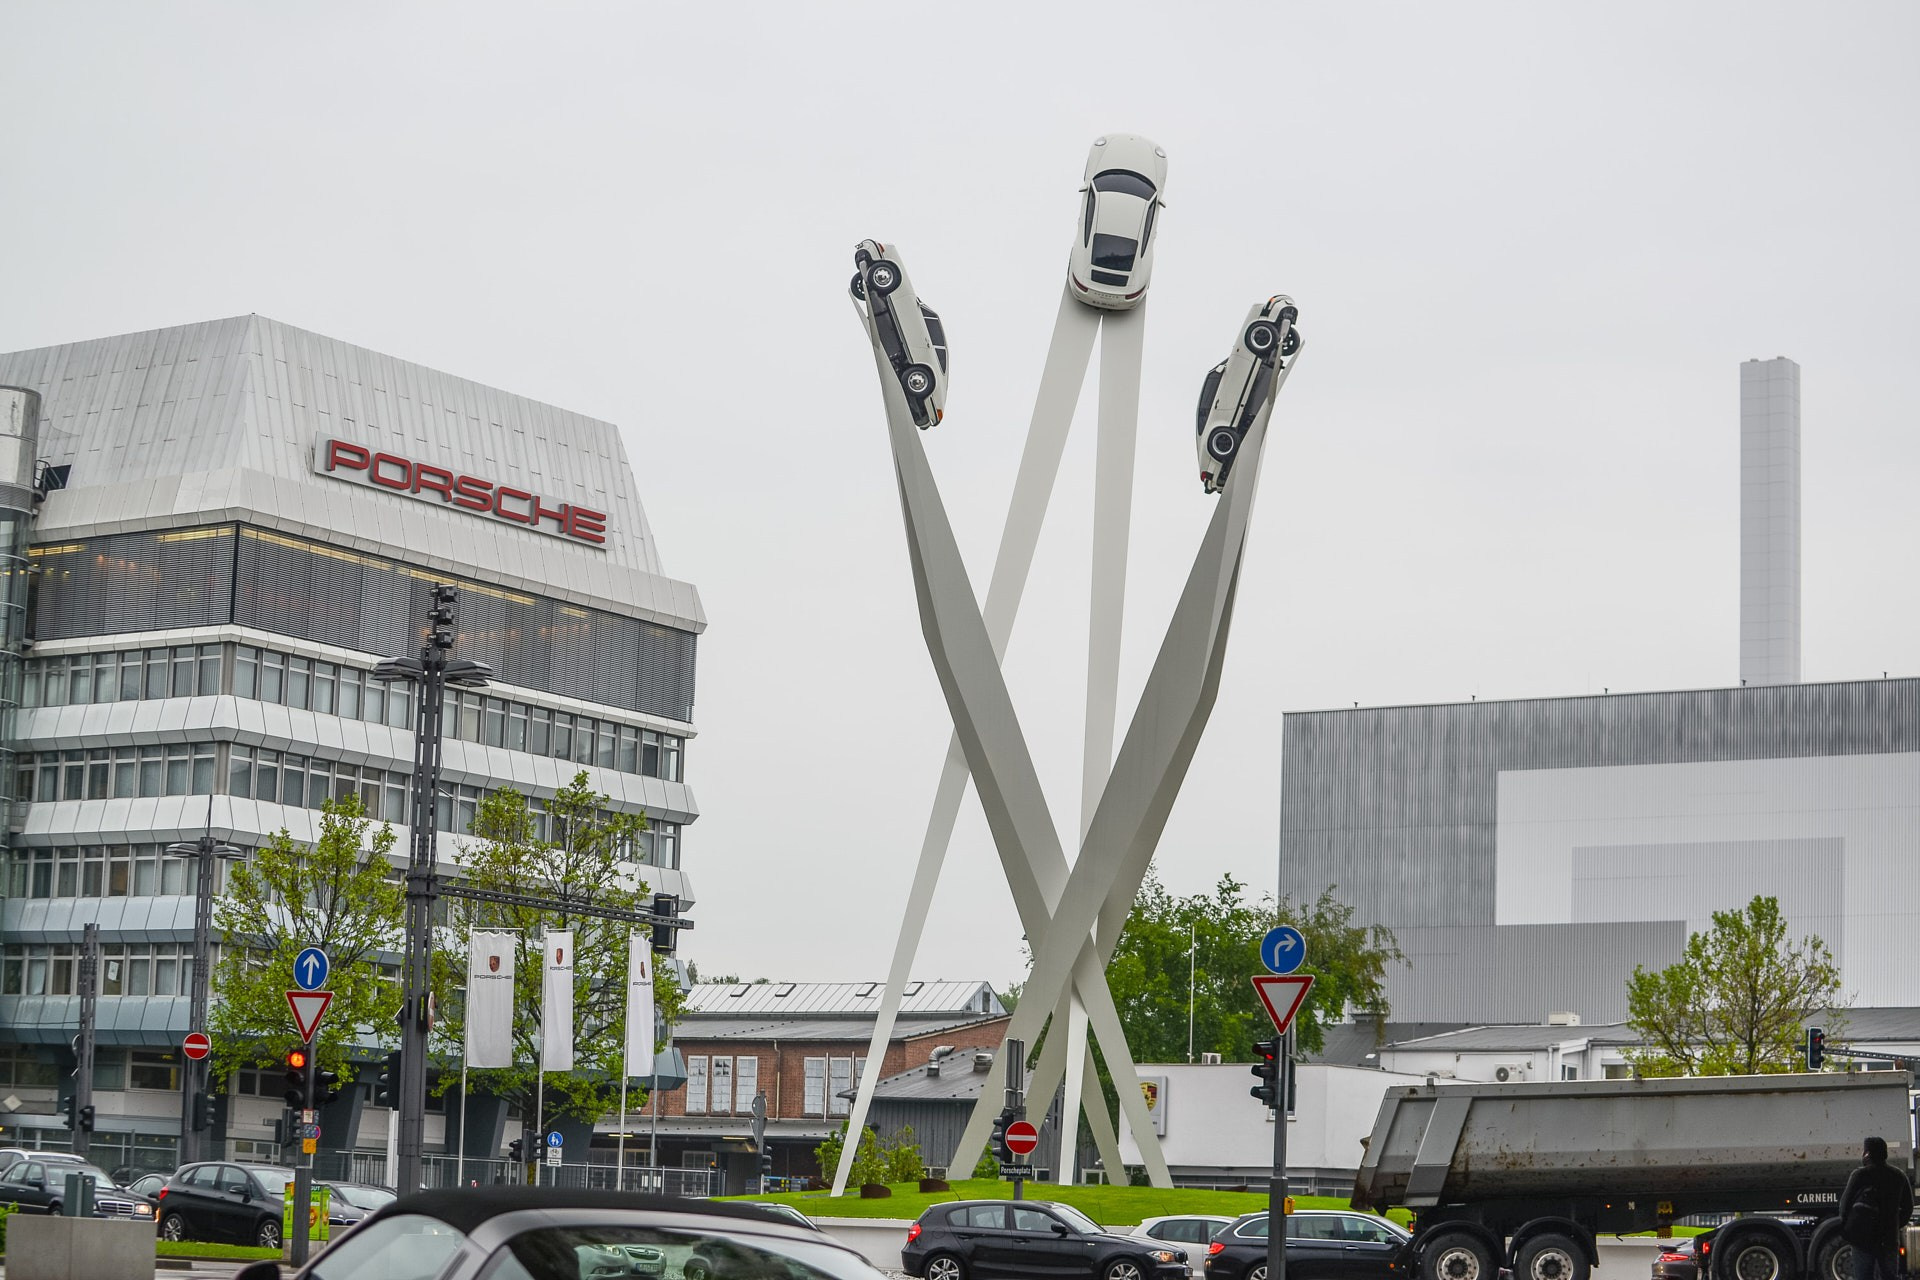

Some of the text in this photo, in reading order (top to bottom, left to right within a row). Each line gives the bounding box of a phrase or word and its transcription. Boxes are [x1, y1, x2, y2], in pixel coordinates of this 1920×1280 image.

[328, 439, 606, 544] PORSCHE
[1001, 1167, 1031, 1175] Porscheplatz
[1797, 1193, 1838, 1203] CARNEHL
